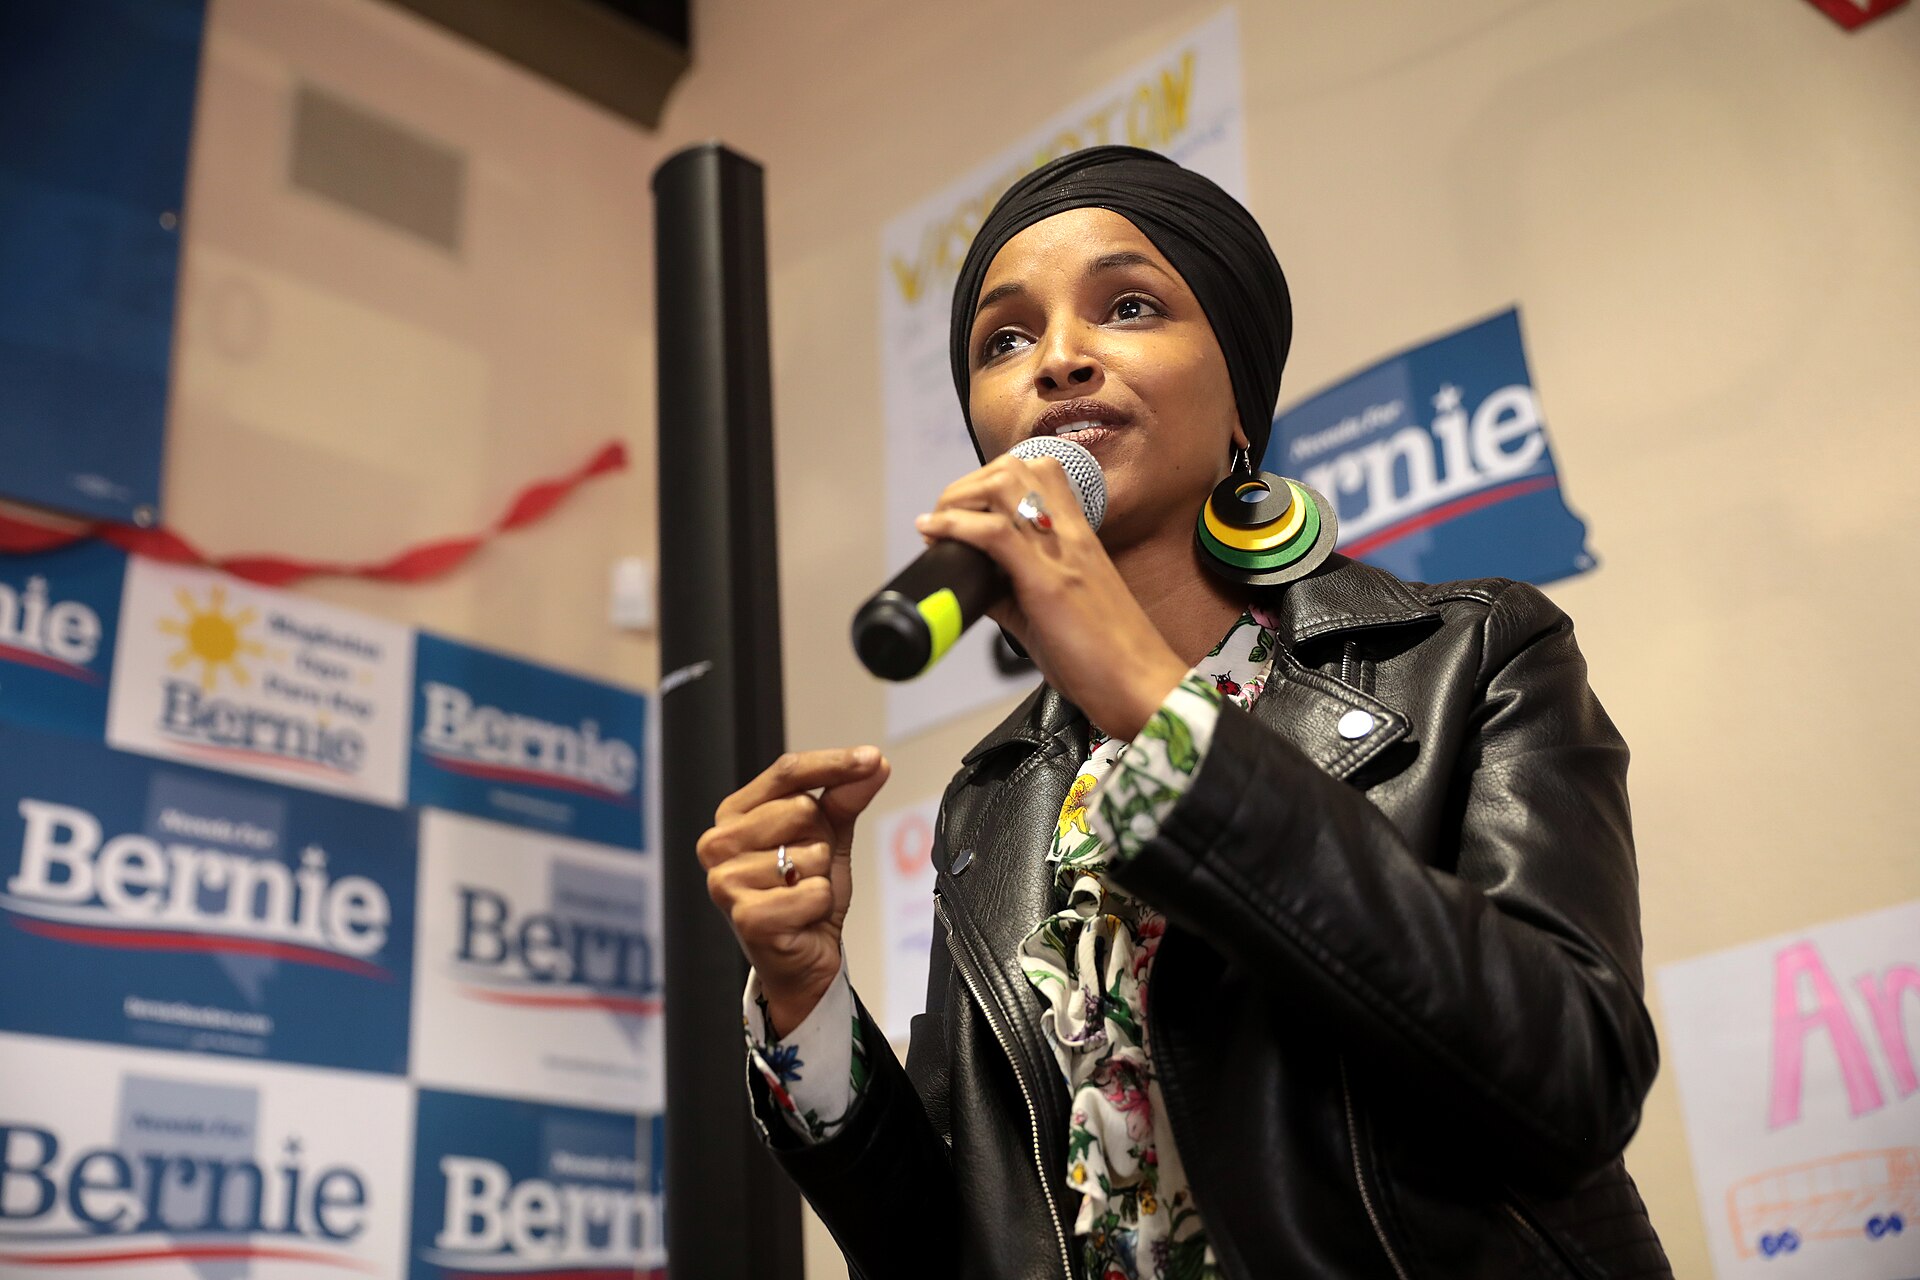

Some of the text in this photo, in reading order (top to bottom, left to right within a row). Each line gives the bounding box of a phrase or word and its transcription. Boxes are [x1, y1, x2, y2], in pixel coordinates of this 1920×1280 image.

[161, 680, 366, 771] Bernie
[420, 682, 639, 796] Bernie
[7, 798, 391, 957] Bernie
[0, 1119, 368, 1241] Bernie
